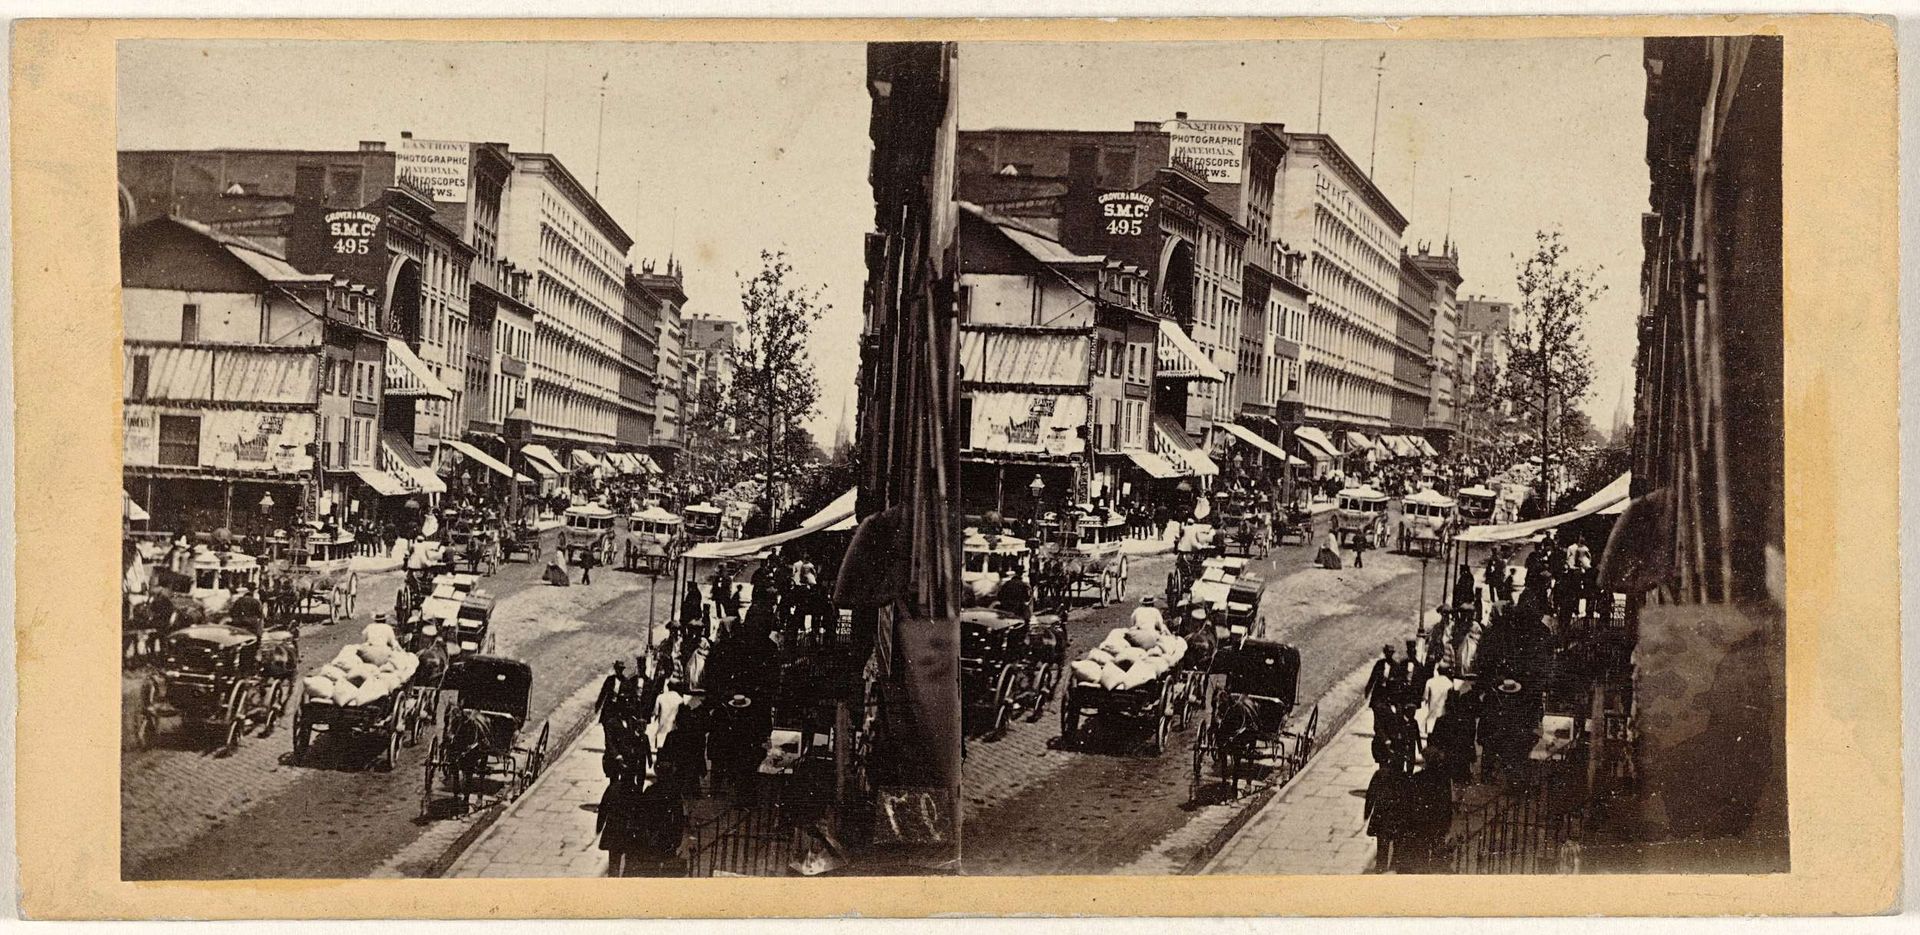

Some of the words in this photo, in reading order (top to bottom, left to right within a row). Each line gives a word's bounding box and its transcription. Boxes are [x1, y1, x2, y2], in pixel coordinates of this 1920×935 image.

[1171, 134, 1242, 146] PHOTOGRAPHIC
[397, 153, 467, 166] PHOTOGRAPHIC
[1098, 192, 1126, 204] GROVER
[1130, 192, 1155, 206] BAKER
[324, 211, 352, 223] GROVER
[357, 211, 381, 226] BAKER
[1106, 219, 1142, 236] 495
[333, 238, 369, 255] 495
